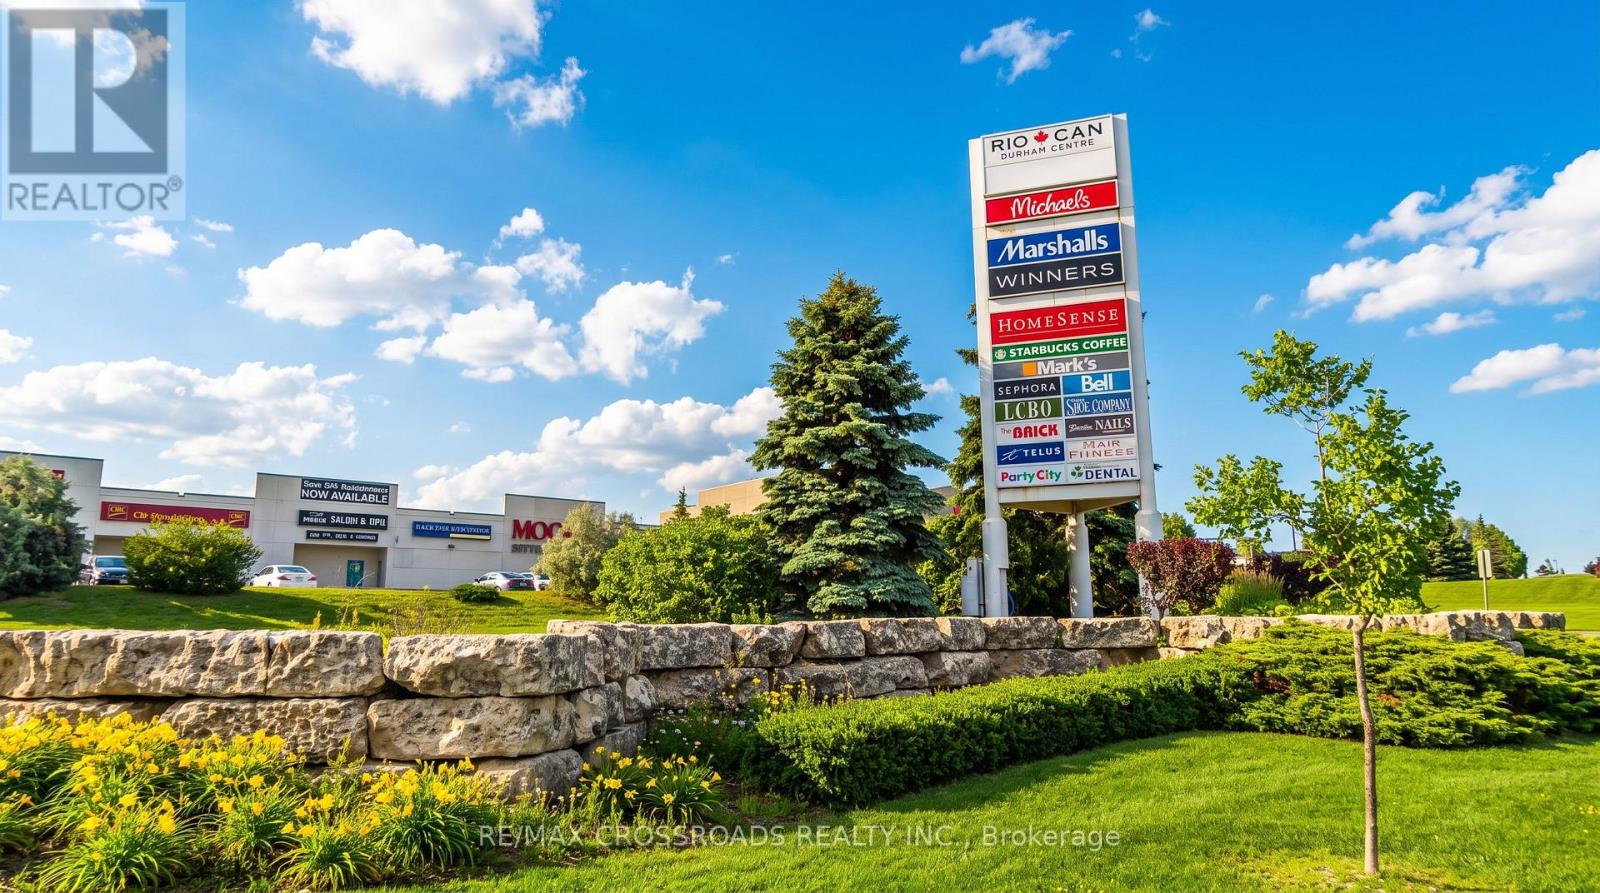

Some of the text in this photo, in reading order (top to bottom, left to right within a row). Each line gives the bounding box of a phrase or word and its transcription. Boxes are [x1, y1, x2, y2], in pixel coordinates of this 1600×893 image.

[991, 122, 1103, 152] RIO CAN
[1001, 138, 1095, 160] DURHAM CENTRE
[1010, 188, 1091, 218] Michaels
[997, 229, 1109, 263] Marshalls
[996, 262, 1115, 288] WINNERS
[1009, 337, 1127, 358] STARBUCKS COFFEE
[1037, 357, 1098, 375] Mark's
[998, 382, 1057, 396] SEPHORA
[1081, 373, 1114, 393] Bell
[1004, 399, 1052, 421] LCBO
[1092, 398, 1132, 413] COMPANY
[1001, 427, 1012, 435] The
[1012, 423, 1059, 439] BRICK
[1094, 417, 1132, 431] NAILS
[1023, 446, 1062, 457] TELUS
[1001, 467, 1062, 484] Party City
[1085, 467, 1138, 480] DENTAL
[301, 489, 388, 504] NOW AVAILABLE
